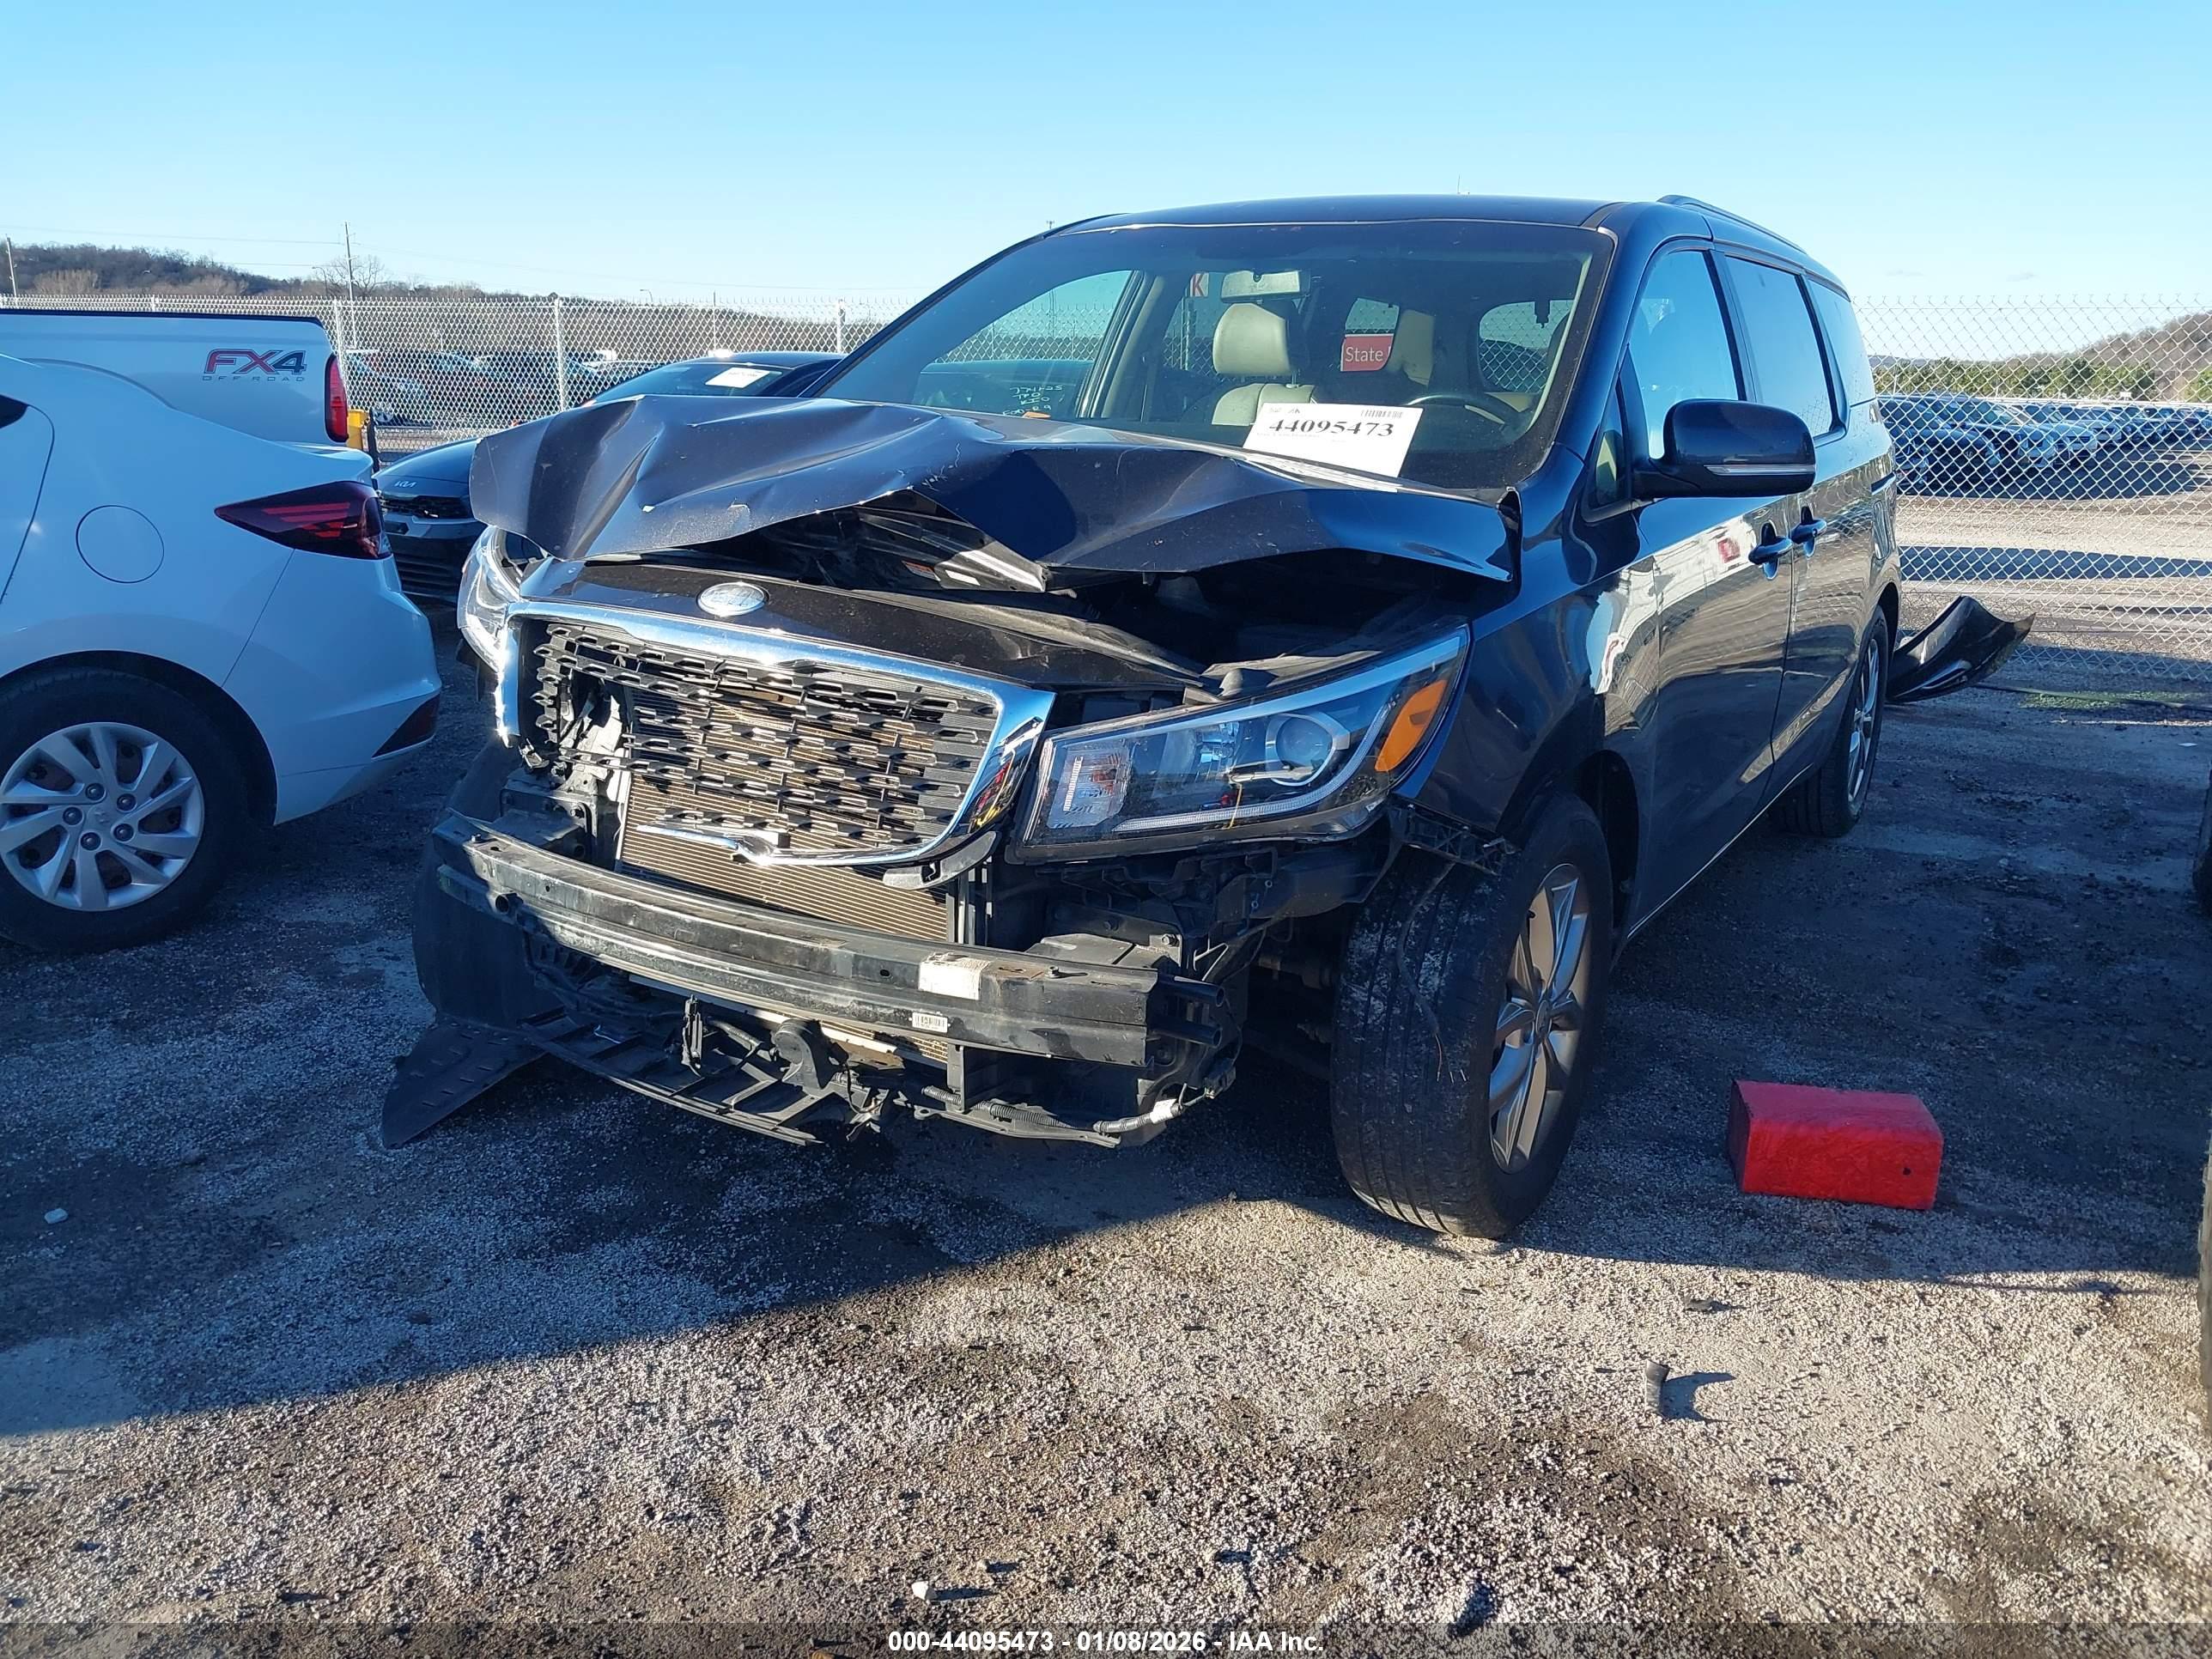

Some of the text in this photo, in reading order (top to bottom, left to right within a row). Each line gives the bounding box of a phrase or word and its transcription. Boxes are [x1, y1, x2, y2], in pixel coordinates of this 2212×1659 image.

[204, 349, 307, 374] FX4
[1346, 346, 1384, 362] State
[1268, 418, 1395, 437] 44095473
